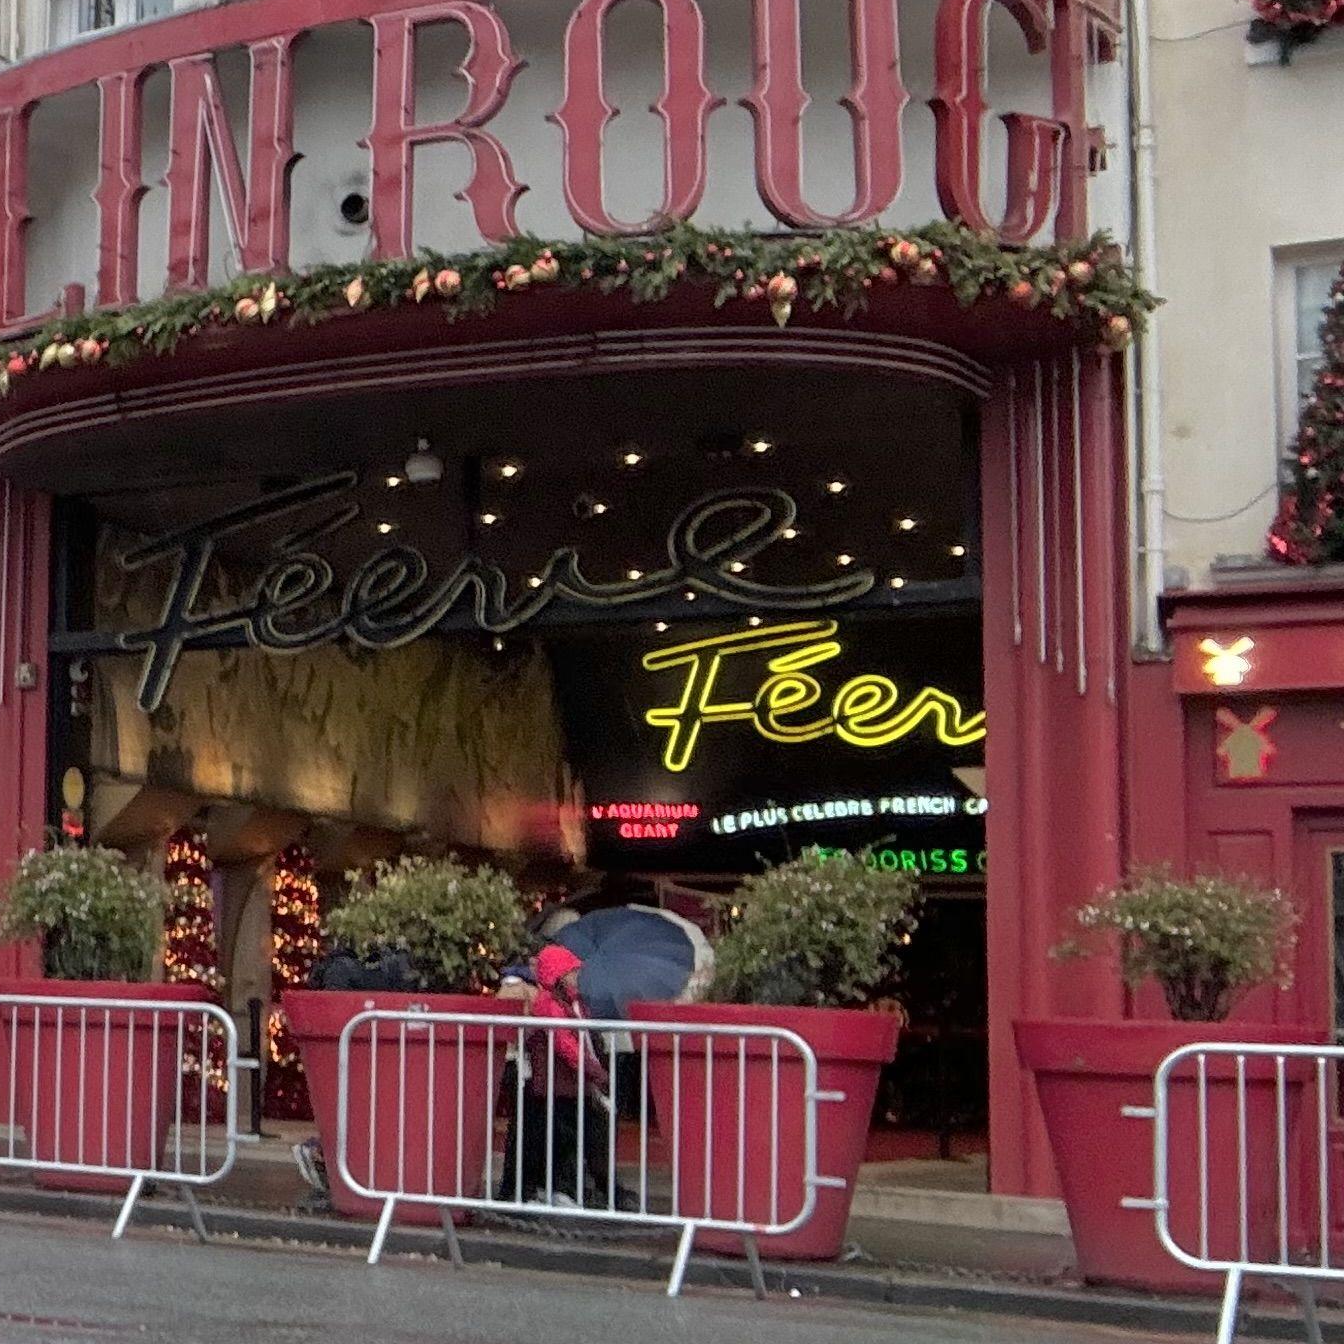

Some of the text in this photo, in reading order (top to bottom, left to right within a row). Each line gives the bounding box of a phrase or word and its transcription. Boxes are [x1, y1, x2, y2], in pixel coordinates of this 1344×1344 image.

[642, 618, 987, 772] Féer
[607, 802, 699, 819] AQUARIUM
[711, 814, 737, 835] LE
[739, 806, 789, 831] PLUS
[878, 794, 956, 816] FRENCH
